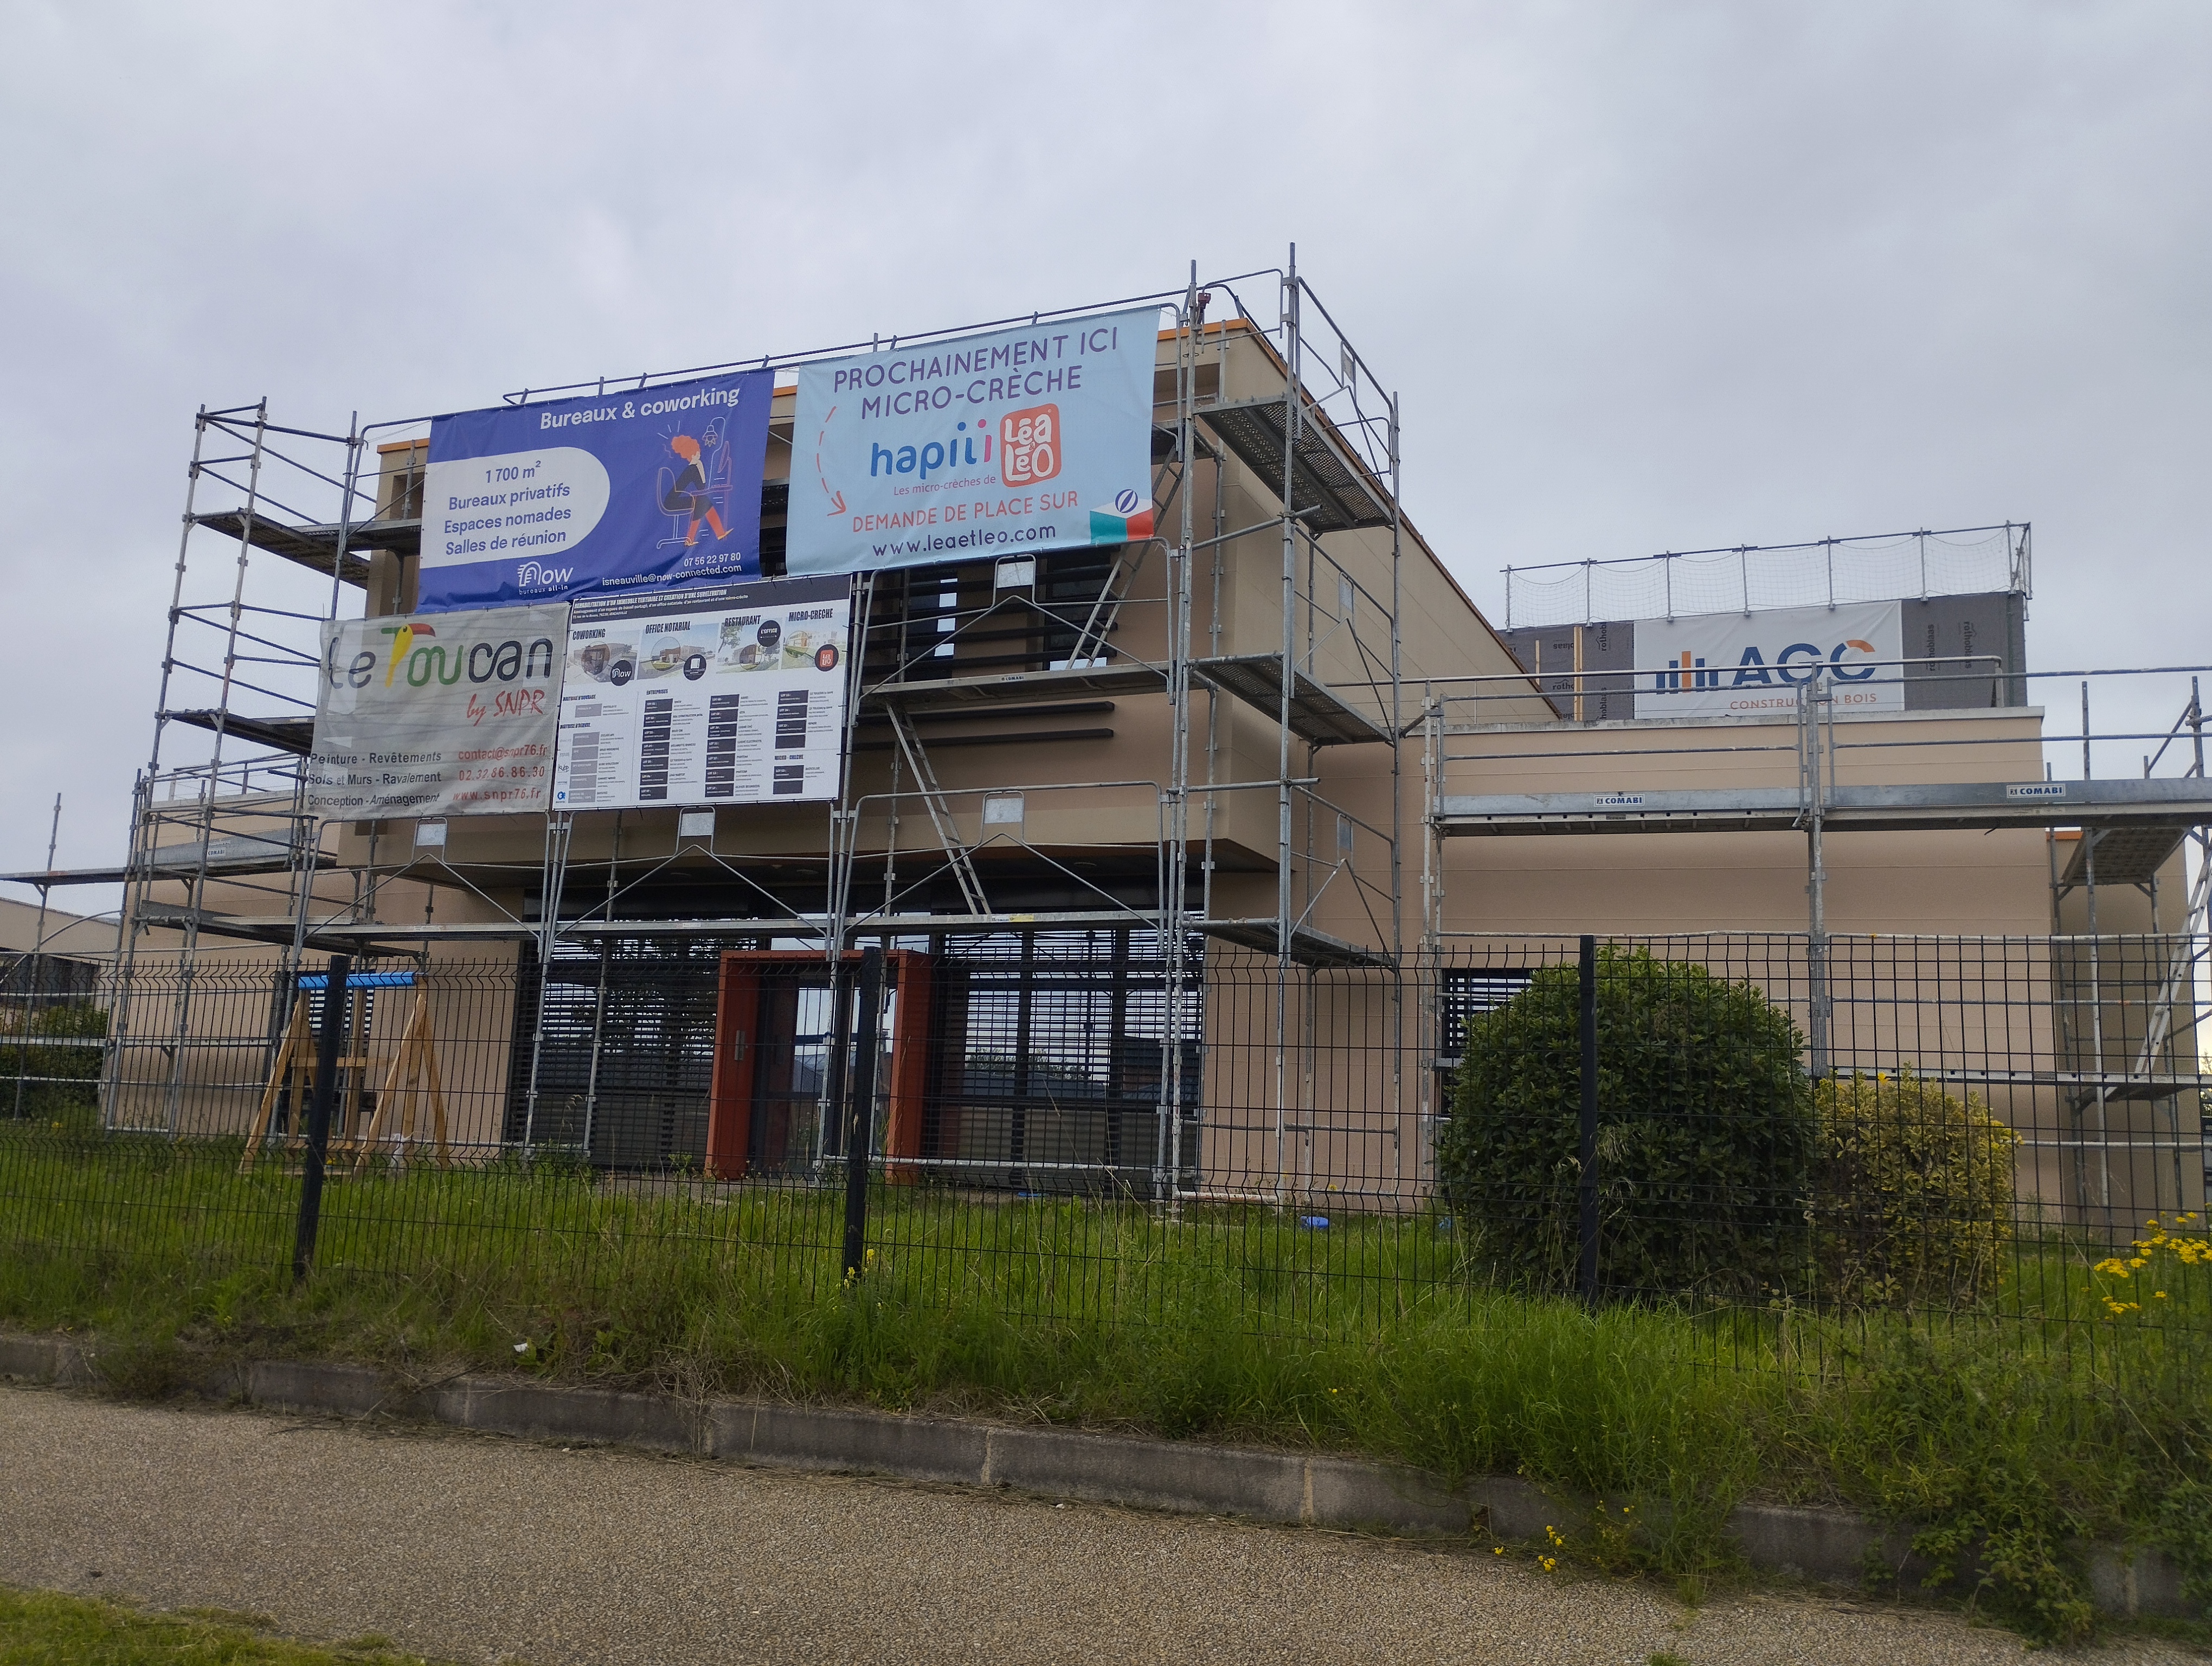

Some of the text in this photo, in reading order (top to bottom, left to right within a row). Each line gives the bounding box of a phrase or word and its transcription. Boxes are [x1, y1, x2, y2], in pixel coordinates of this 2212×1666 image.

[834, 326, 1117, 393] PROCHAINEMENT ICI
[861, 364, 1083, 420] MICRO-CRÈCHE
[541, 387, 741, 430] Bureaux & coworking
[485, 460, 541, 483] 1 700 m²
[894, 475, 996, 496] Les micro-crèches de
[449, 484, 570, 511] Bureaux privatifs
[444, 506, 571, 535] Espaces nomades
[853, 490, 1078, 533] DEMANDE DE PLACE SUR
[445, 530, 567, 555] Salles de réunion
[873, 525, 1056, 556] www.leaetleo.com
[684, 552, 741, 567] 07 56 22 97 80
[602, 563, 742, 586] isneauville@now-connected.com
[548, 584, 569, 593] all-in
[645, 621, 691, 634] OFFICE NOTARIAL
[724, 615, 761, 627] RESTAURANT
[573, 629, 606, 640] COWORKING
[1926, 624, 1935, 671] rohoblaas
[1732, 639, 1876, 687] AGC
[493, 689, 545, 717] SNPR
[1730, 693, 1876, 710] CONSTRUN BOIS
[310, 753, 357, 764] Peinture
[369, 752, 441, 764] Revêtements
[458, 744, 547, 760] contact@snpr76.fr
[308, 773, 333, 785] Sols
[337, 776, 345, 785] et
[348, 774, 372, 785] Murs
[383, 772, 441, 784] Ravalement
[453, 787, 541, 802] www.snpr76.fr
[2020, 786, 2062, 794] COMABI
[308, 794, 363, 810] Conception
